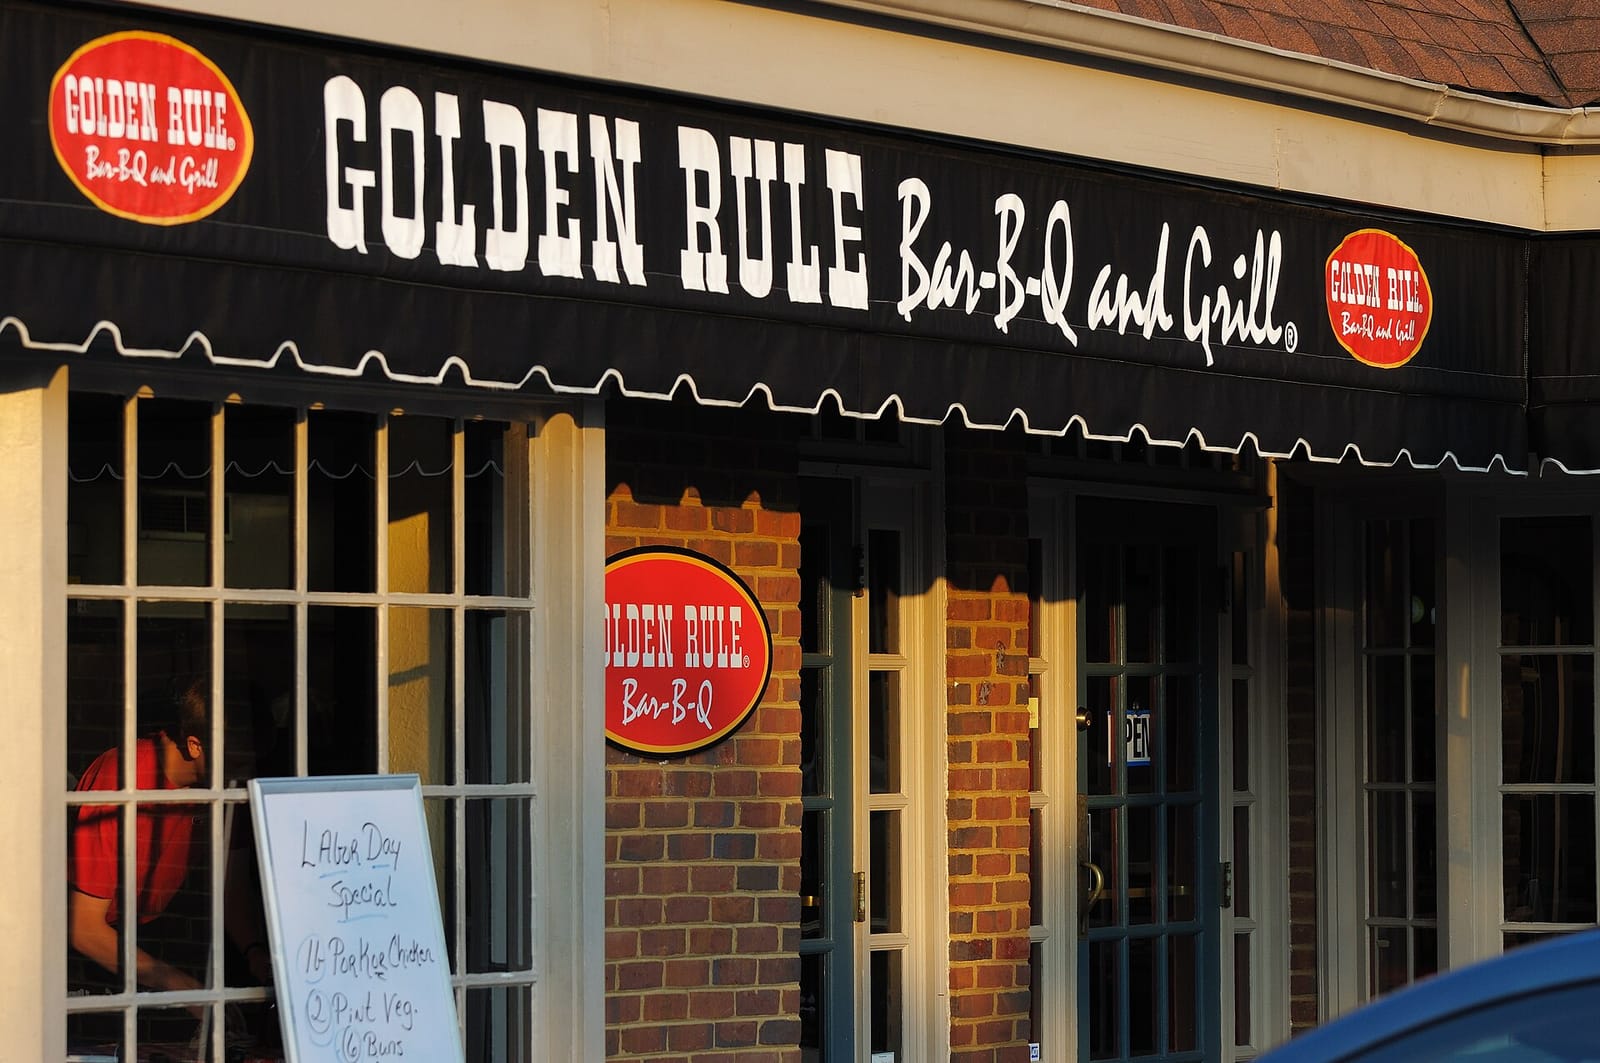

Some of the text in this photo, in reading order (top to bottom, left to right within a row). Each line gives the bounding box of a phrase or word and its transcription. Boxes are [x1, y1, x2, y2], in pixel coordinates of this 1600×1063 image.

[64, 74, 158, 142] GOLDEN
[150, 155, 176, 186] and
[179, 156, 218, 195] Grill
[323, 74, 647, 287] GOLDEN
[677, 126, 869, 311] RULE
[897, 177, 1078, 347] Bar-B-Q
[1088, 221, 1173, 341] and
[1331, 259, 1380, 308] GOLDEN
[1376, 319, 1392, 340] and
[1396, 320, 1414, 346] Grill
[605, 602, 673, 668] LDEN
[622, 678, 713, 730] Bar-B-Q
[1126, 717, 1151, 758] PEN
[361, 822, 402, 871] Day
[328, 875, 397, 920] Special
[388, 934, 435, 969] Chicken
[363, 1031, 404, 1058] Buns
